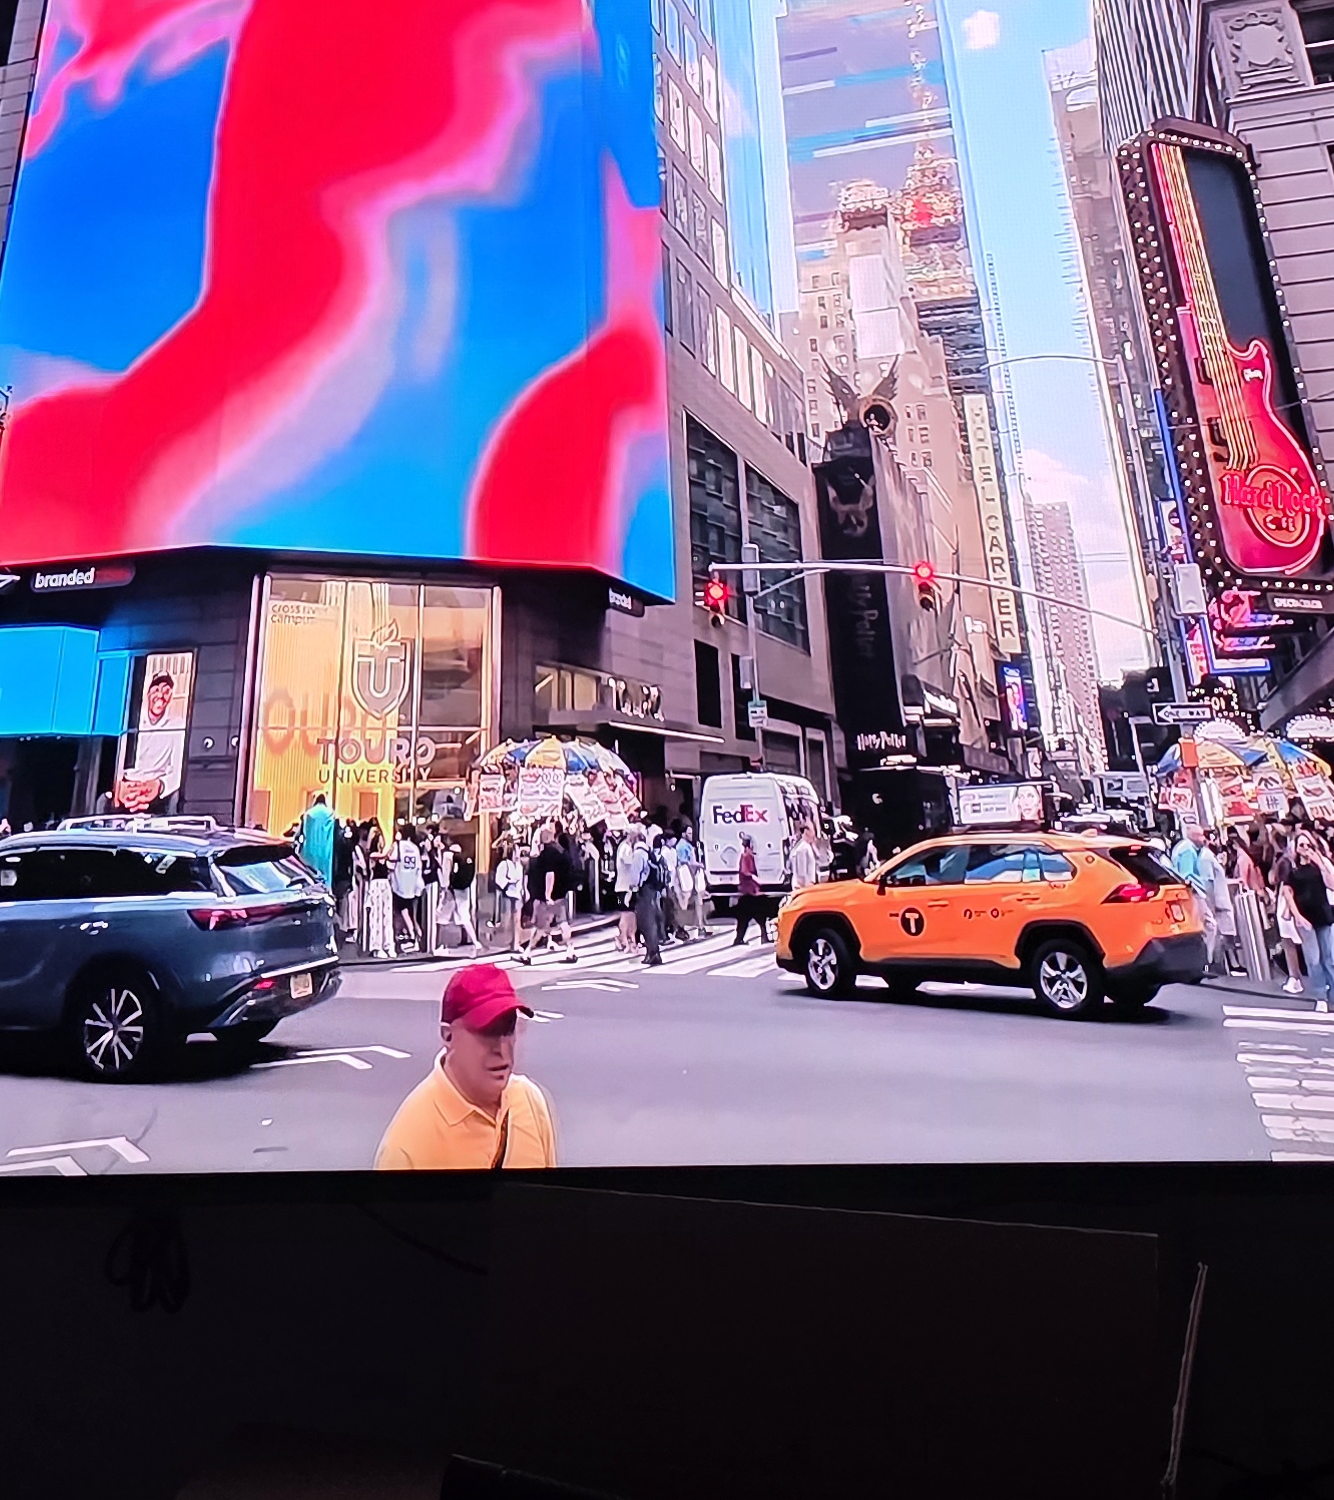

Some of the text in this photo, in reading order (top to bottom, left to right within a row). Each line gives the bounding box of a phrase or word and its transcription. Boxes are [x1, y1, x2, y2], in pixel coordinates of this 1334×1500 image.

[35, 567, 95, 588] branded
[317, 737, 436, 765] TOURO
[319, 767, 431, 784] UNIVERSITY
[712, 804, 769, 825] FedEx
